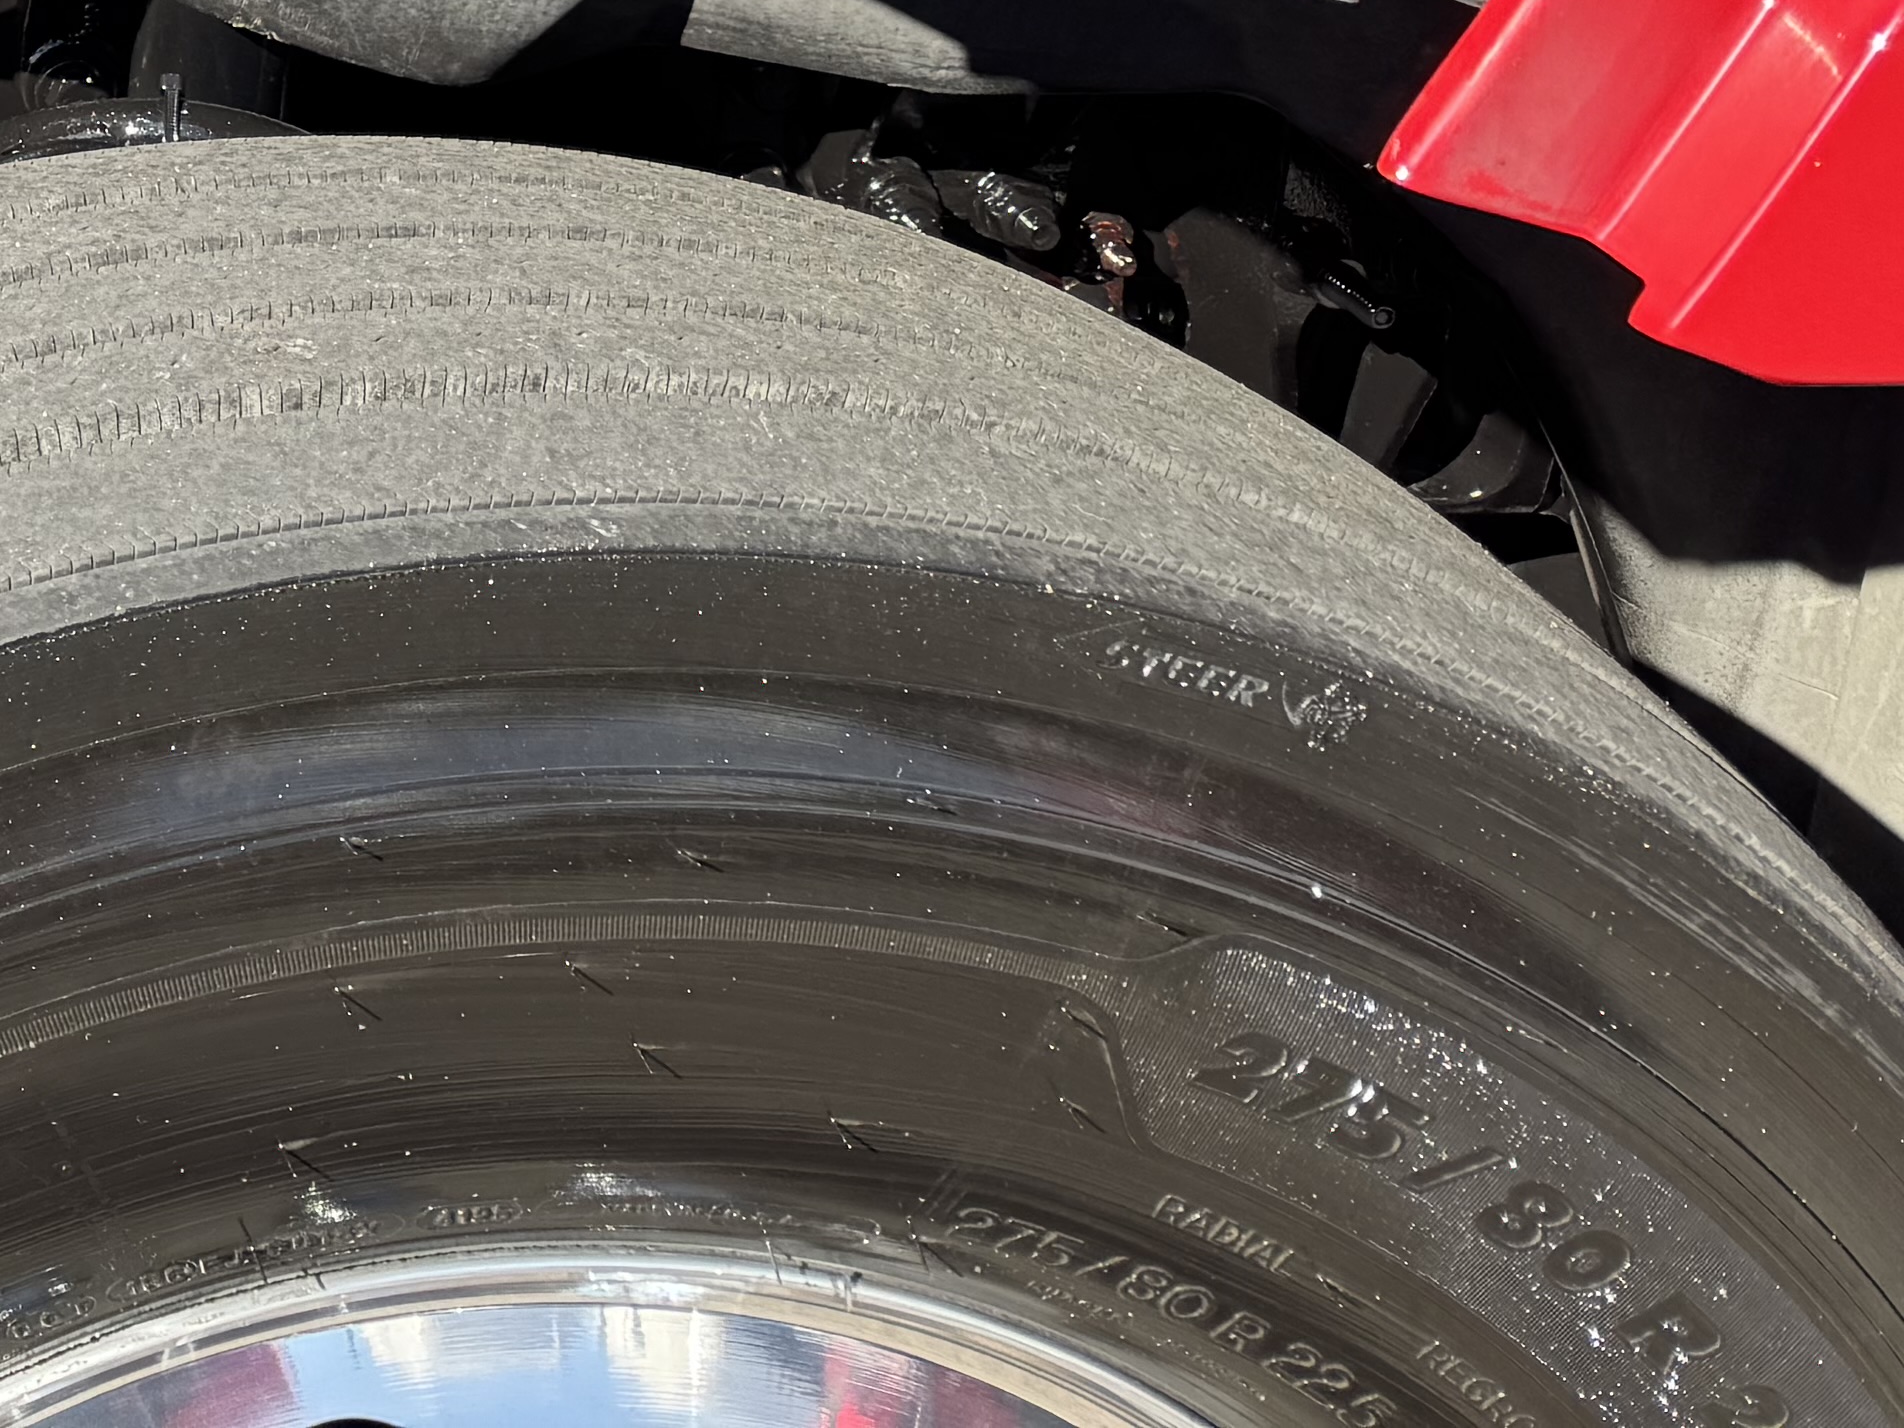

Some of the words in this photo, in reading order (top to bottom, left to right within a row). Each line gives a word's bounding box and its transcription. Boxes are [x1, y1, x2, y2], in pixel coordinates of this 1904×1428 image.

[1095, 640, 1270, 708] STEER
[1149, 1193, 1300, 1279] RADIAL
[947, 1206, 1217, 1322] 275/80
[1210, 1310, 1274, 1353] R
[1616, 1291, 1722, 1378] R
